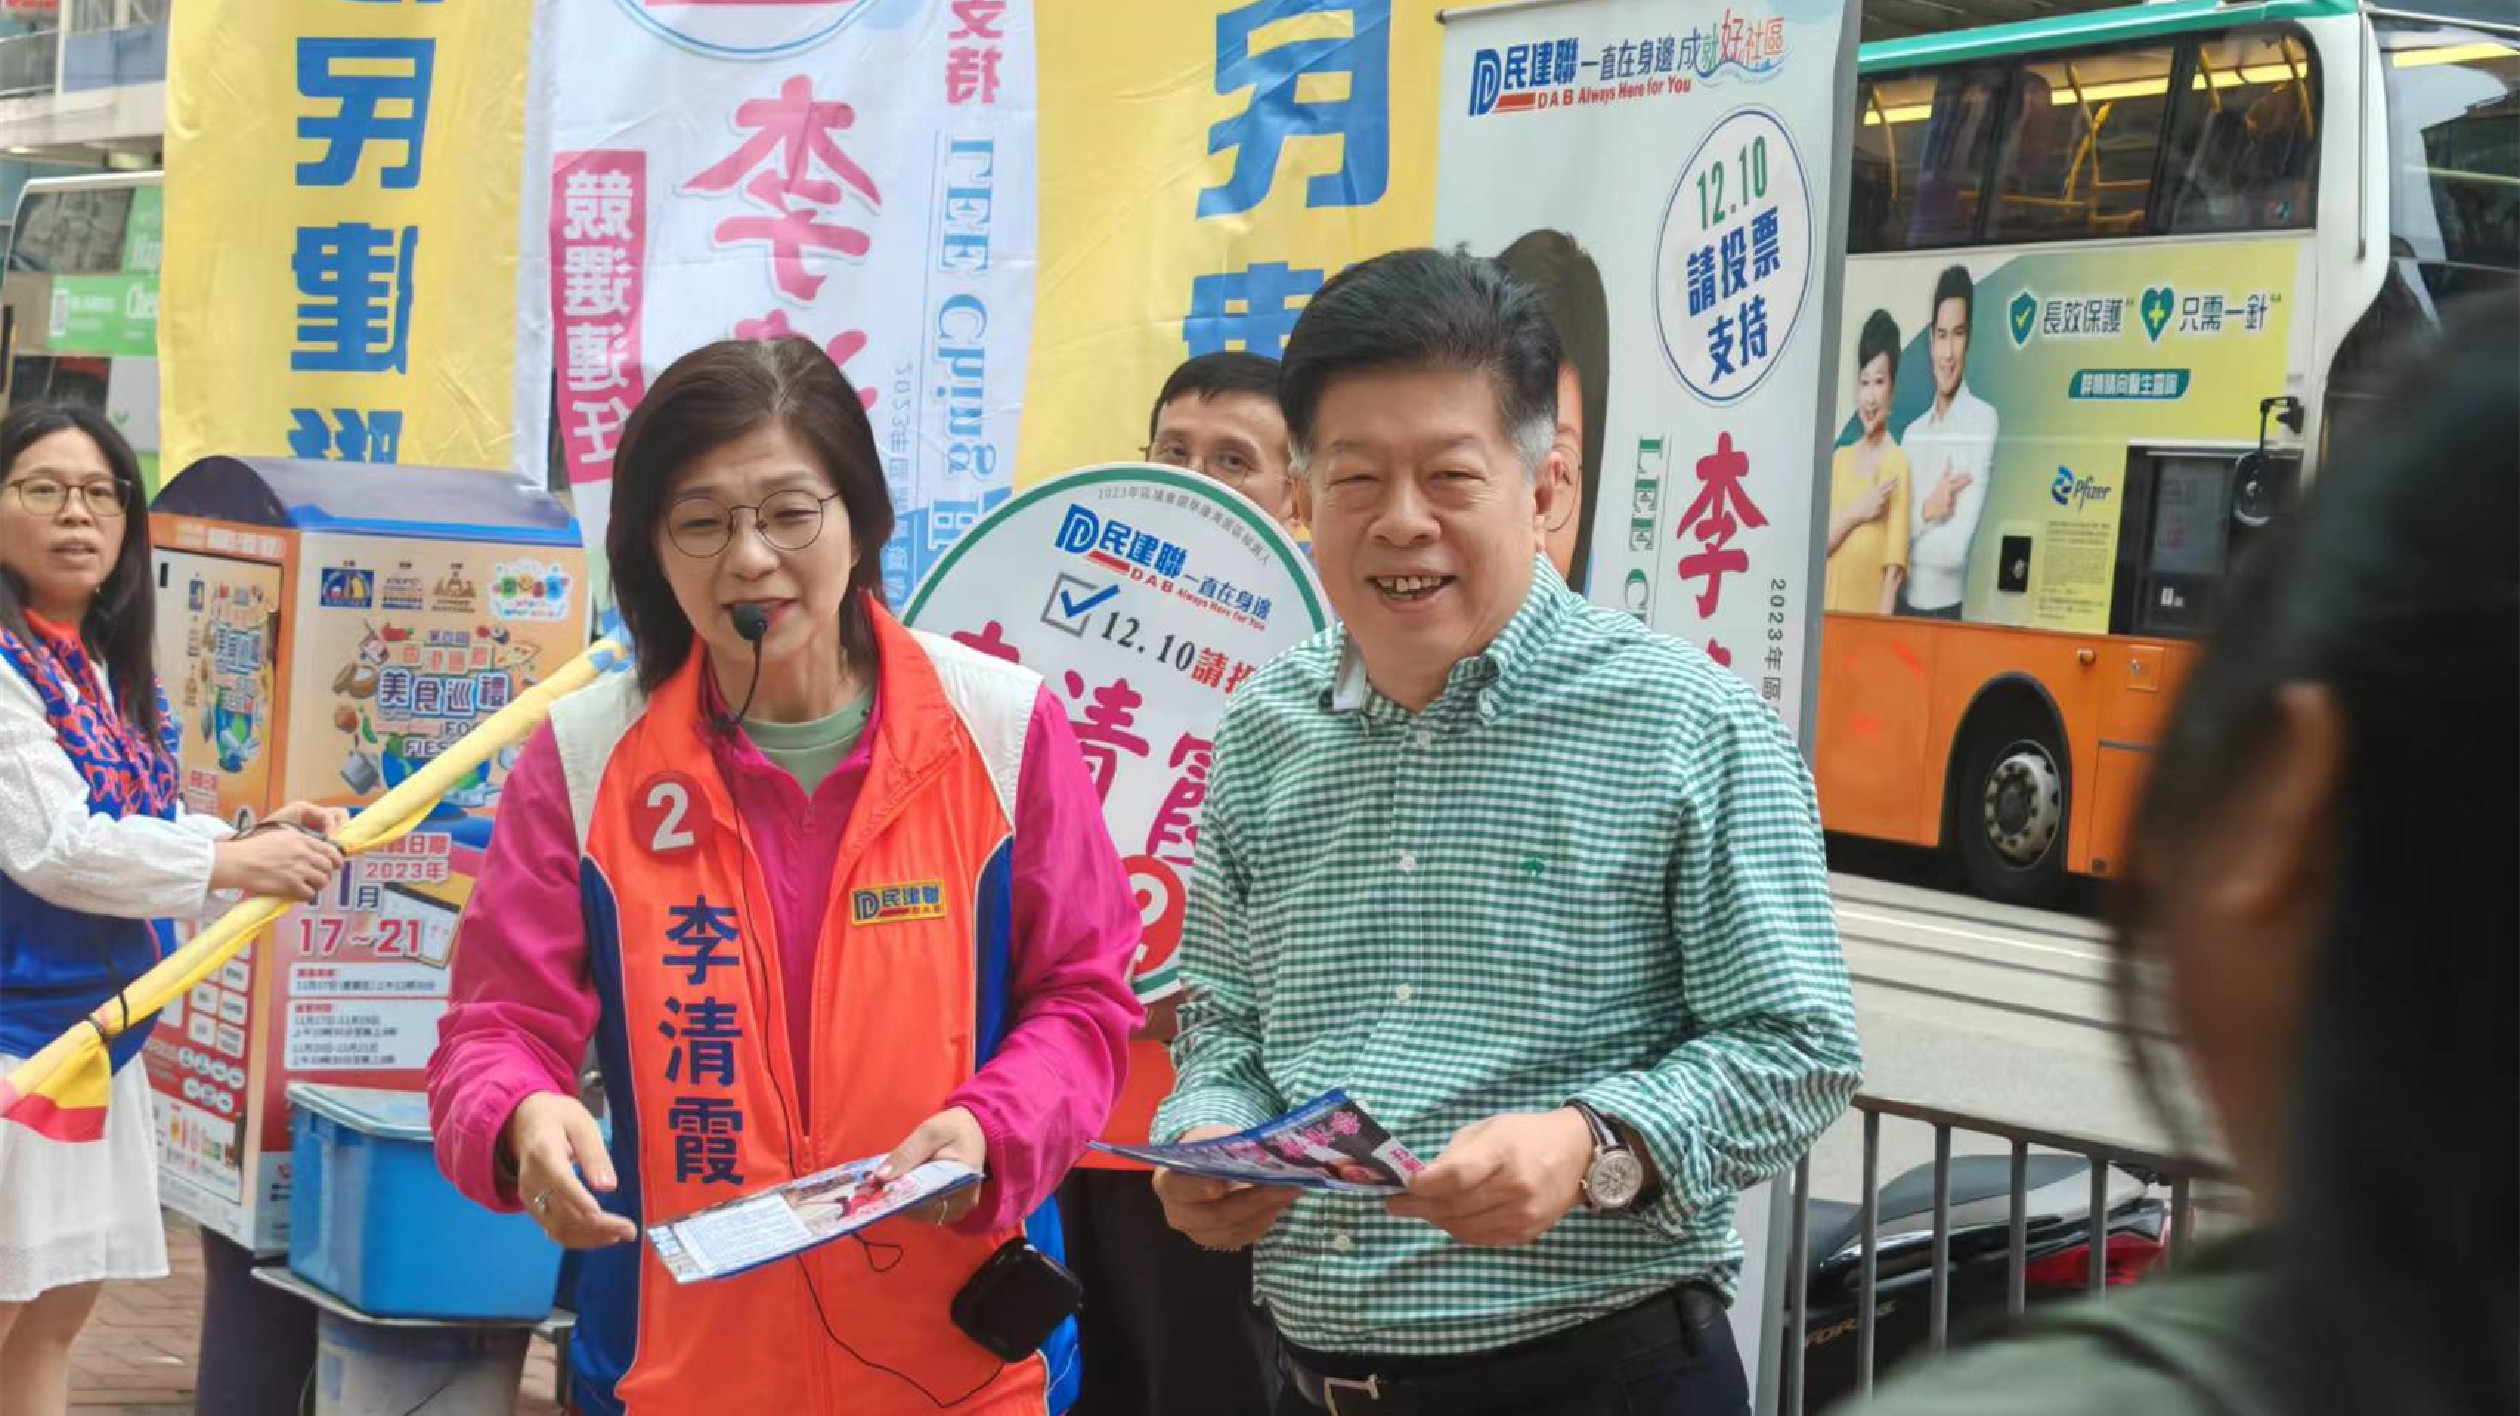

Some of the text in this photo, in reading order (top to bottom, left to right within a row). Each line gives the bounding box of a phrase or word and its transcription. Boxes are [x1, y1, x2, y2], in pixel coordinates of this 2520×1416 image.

[1504, 37, 1579, 91] 民建聯
[1578, 82, 1616, 106] Always
[1618, 80, 1644, 99] Here
[1646, 77, 1664, 97] for
[1668, 75, 1692, 94] You
[1697, 135, 1768, 230] 12.10
[1687, 206, 1781, 318] 請投票
[1708, 294, 1768, 385] 支持
[2043, 294, 2267, 334] 長效保護 只需一針
[1624, 434, 1665, 622] LEE C
[2074, 475, 2112, 512] Pfizer
[1099, 519, 1188, 579] 民建聯
[1676, 431, 1770, 668] 李
[1762, 577, 1786, 716] 2023年區
[382, 671, 507, 713] 美食巡禮
[646, 782, 695, 852] 2
[366, 862, 445, 880] 2023年
[659, 894, 744, 1185] 李清霞
